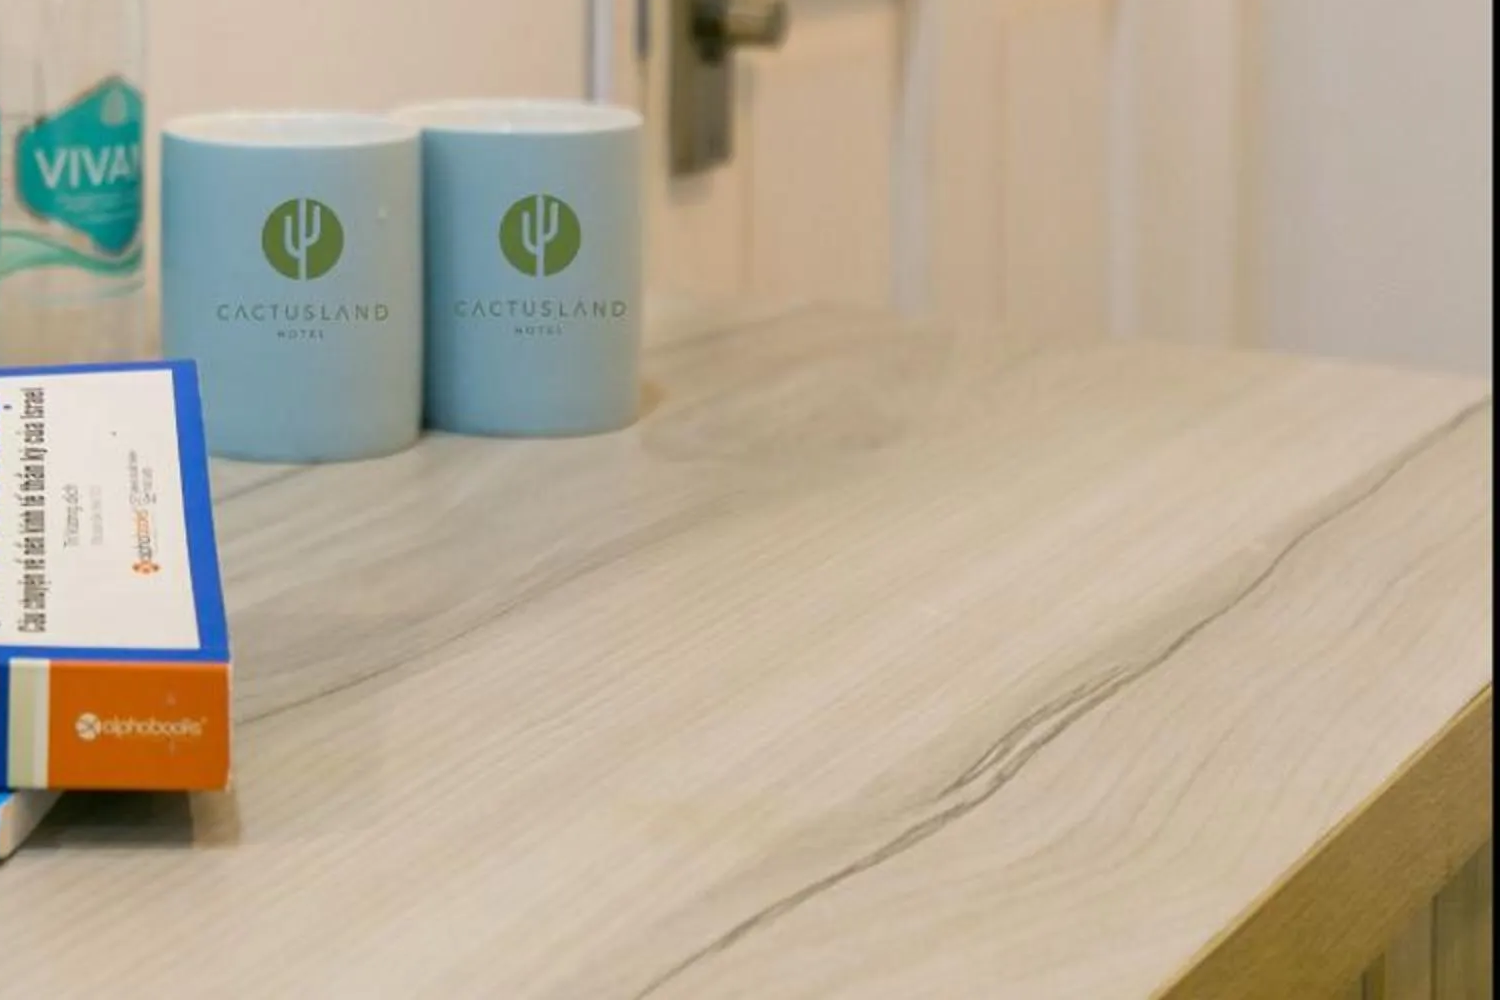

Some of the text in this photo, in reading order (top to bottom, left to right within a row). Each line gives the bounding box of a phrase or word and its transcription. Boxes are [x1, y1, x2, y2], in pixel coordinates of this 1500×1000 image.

[216, 303, 390, 322] CACTUSLAND
[455, 300, 628, 317] CACTUSLAND
[277, 330, 325, 339] HOTEL
[515, 326, 563, 336] HOTEL
[19, 387, 46, 420] Israel
